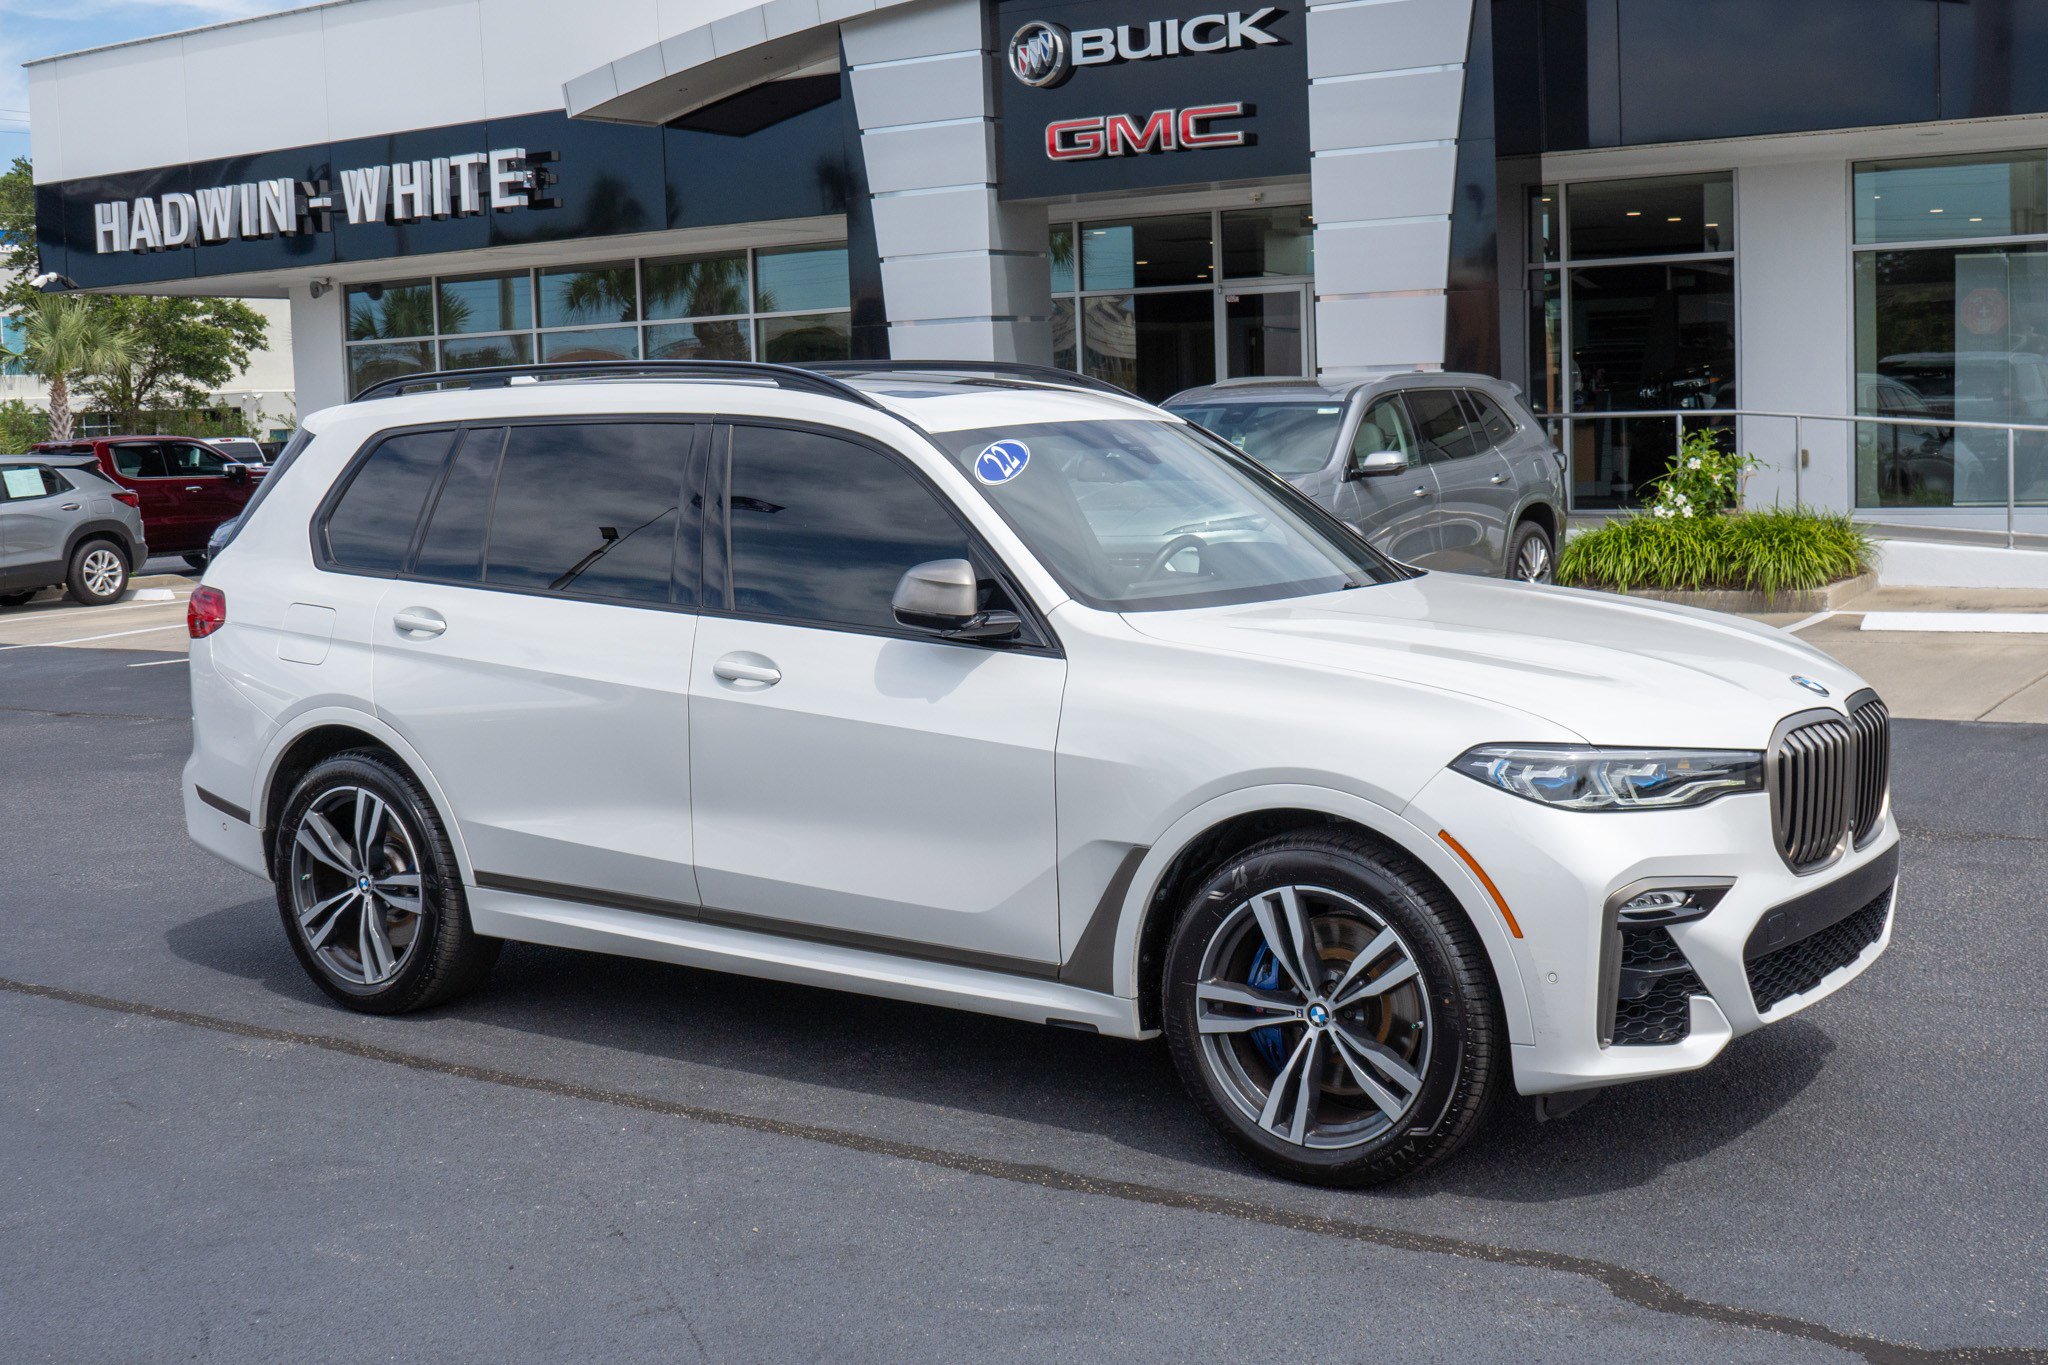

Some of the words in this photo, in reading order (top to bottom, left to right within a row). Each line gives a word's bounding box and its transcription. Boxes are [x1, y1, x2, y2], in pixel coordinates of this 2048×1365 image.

[1071, 6, 1280, 66] BUICK
[1045, 101, 1246, 162] GMC
[983, 445, 1021, 478] 22
